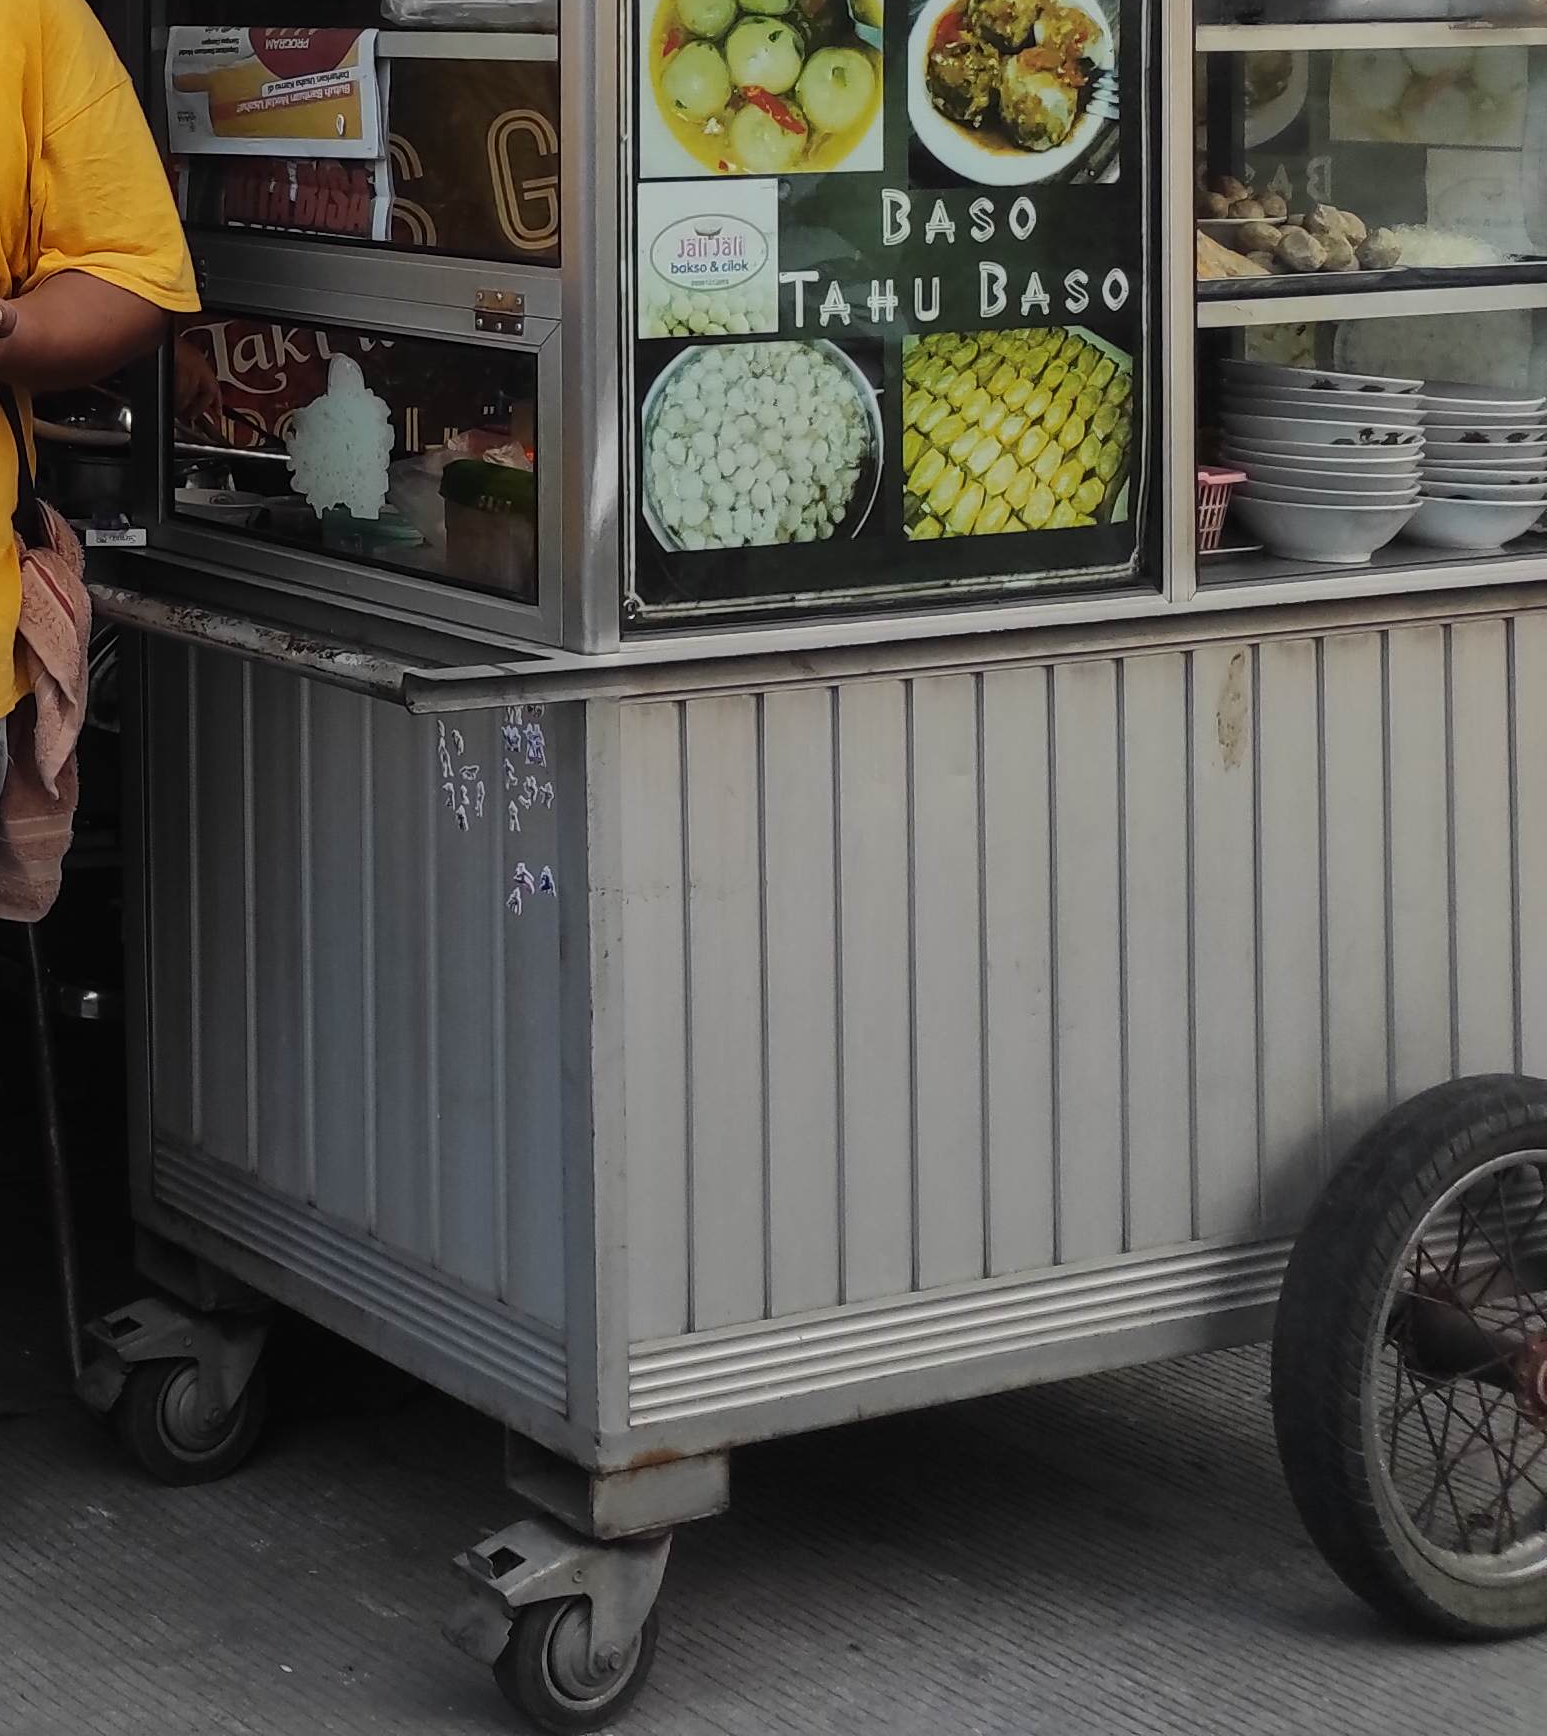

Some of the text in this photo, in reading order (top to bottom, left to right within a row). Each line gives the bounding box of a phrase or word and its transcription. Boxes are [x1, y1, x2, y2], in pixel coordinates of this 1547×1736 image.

[265, 37, 311, 51] PROGRAM
[670, 259, 749, 275] bakso & cilok
